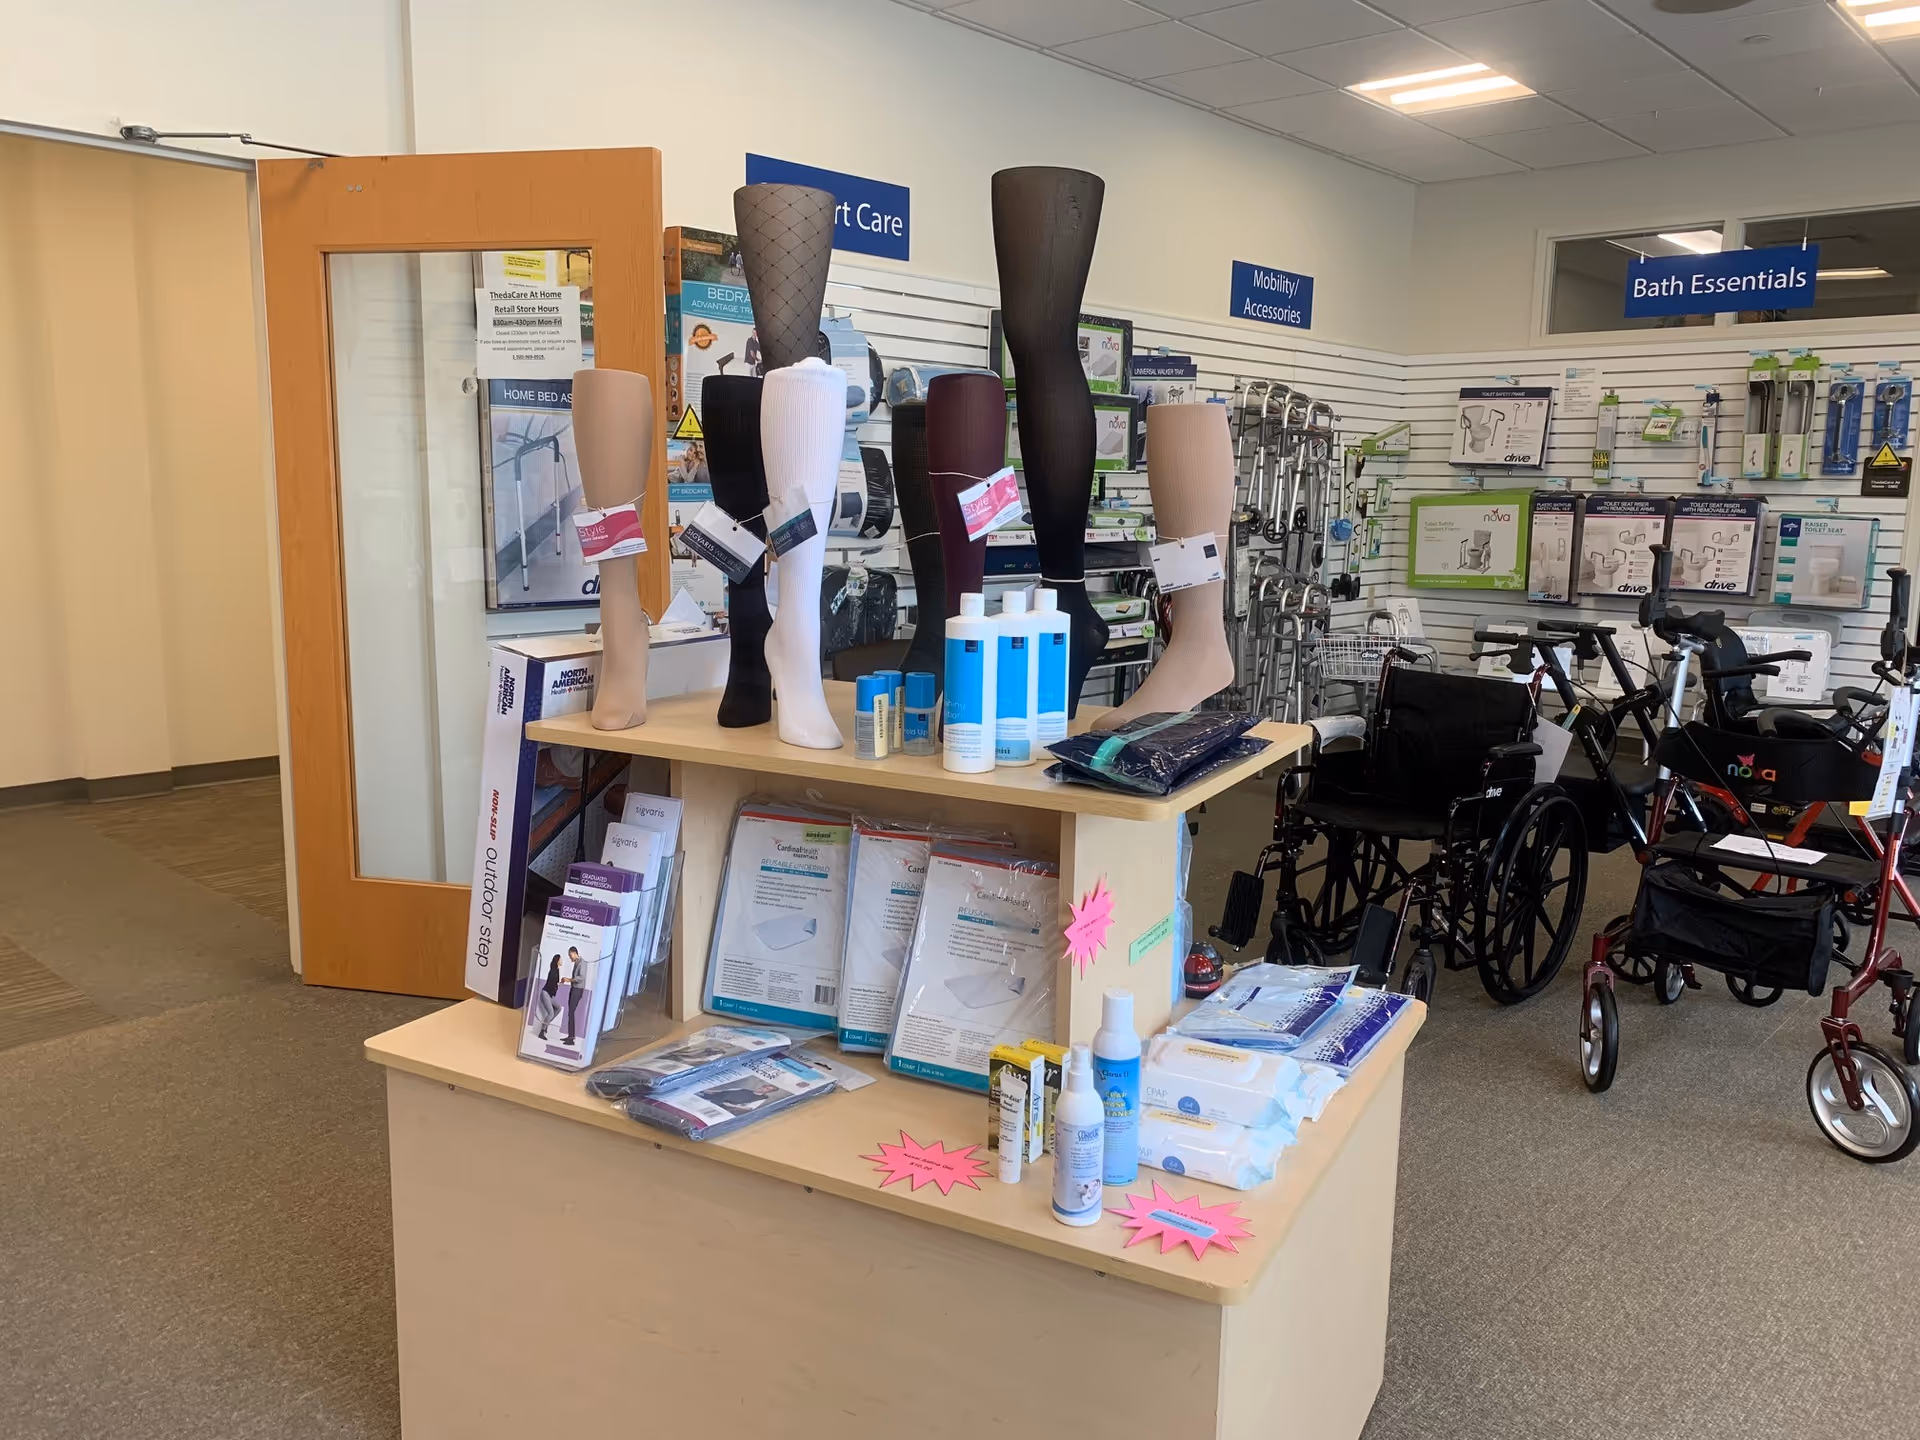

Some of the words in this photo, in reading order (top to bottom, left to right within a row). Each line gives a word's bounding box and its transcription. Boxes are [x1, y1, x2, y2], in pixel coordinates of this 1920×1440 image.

[857, 203, 903, 236] Care
[1253, 269, 1300, 299] Mobility/
[1633, 275, 1684, 298] Bath
[1690, 266, 1806, 294] Essentials
[489, 291, 528, 299] ThedaCare
[540, 290, 562, 298] Home
[494, 305, 515, 313] Retail
[516, 305, 536, 313] Store
[537, 305, 560, 313] Hours
[691, 299, 738, 313] ADVANTAGE
[1243, 297, 1301, 324] Accessories
[537, 318, 562, 326] Mon-Fri
[1101, 339, 1120, 352] nova
[1134, 368, 1157, 376] UNIVERSAL
[1157, 368, 1174, 376] WALKER
[1174, 368, 1185, 376] TRAY
[504, 389, 536, 401] HOME
[537, 391, 559, 402] BED
[1108, 418, 1127, 430] nova
[1504, 453, 1531, 463] drive
[1593, 452, 1609, 462] NEW
[1592, 461, 1610, 469] ITEM
[964, 497, 990, 515] Style
[1483, 508, 1511, 522] nova
[578, 524, 606, 538] Style
[686, 527, 715, 552] SIGVARIS
[727, 556, 746, 573] BEING
[1617, 583, 1648, 594] drive
[1704, 579, 1737, 591] drive
[560, 667, 588, 680] NORTH
[551, 674, 594, 689] AMERICAN
[500, 666, 511, 716] AMERICAN
[506, 676, 516, 709] NORTH
[550, 687, 568, 696] Health
[917, 728, 928, 737] Up
[1727, 763, 1776, 782] nova
[1485, 786, 1503, 799] drive
[489, 789, 500, 841] NON-SLIP
[635, 804, 665, 818] sigvaris
[611, 834, 638, 849] sigvaris
[777, 843, 819, 856] CardinalHealth
[760, 858, 793, 869] REUSABLE
[793, 862, 830, 873] UNDERPAD
[581, 872, 608, 883] GRADUATED
[481, 847, 499, 923] outdoor
[581, 878, 612, 890] COMPRESSION
[574, 889, 593, 897] Graduated
[562, 905, 590, 916] GRADUATED
[561, 911, 595, 923] COMPRESSION
[554, 922, 574, 930] Graduated
[559, 928, 581, 937] Compression
[474, 925, 493, 968] step
[845, 1031, 849, 1039] 1
[897, 1059, 902, 1067] 1
[1102, 1070, 1122, 1078] Citrus
[1123, 1070, 1129, 1078] II
[1104, 1091, 1127, 1099] CPAP
[1146, 1086, 1168, 1098] CPAP
[1184, 1101, 1193, 1109] 64
[1168, 1160, 1178, 1168] 64
